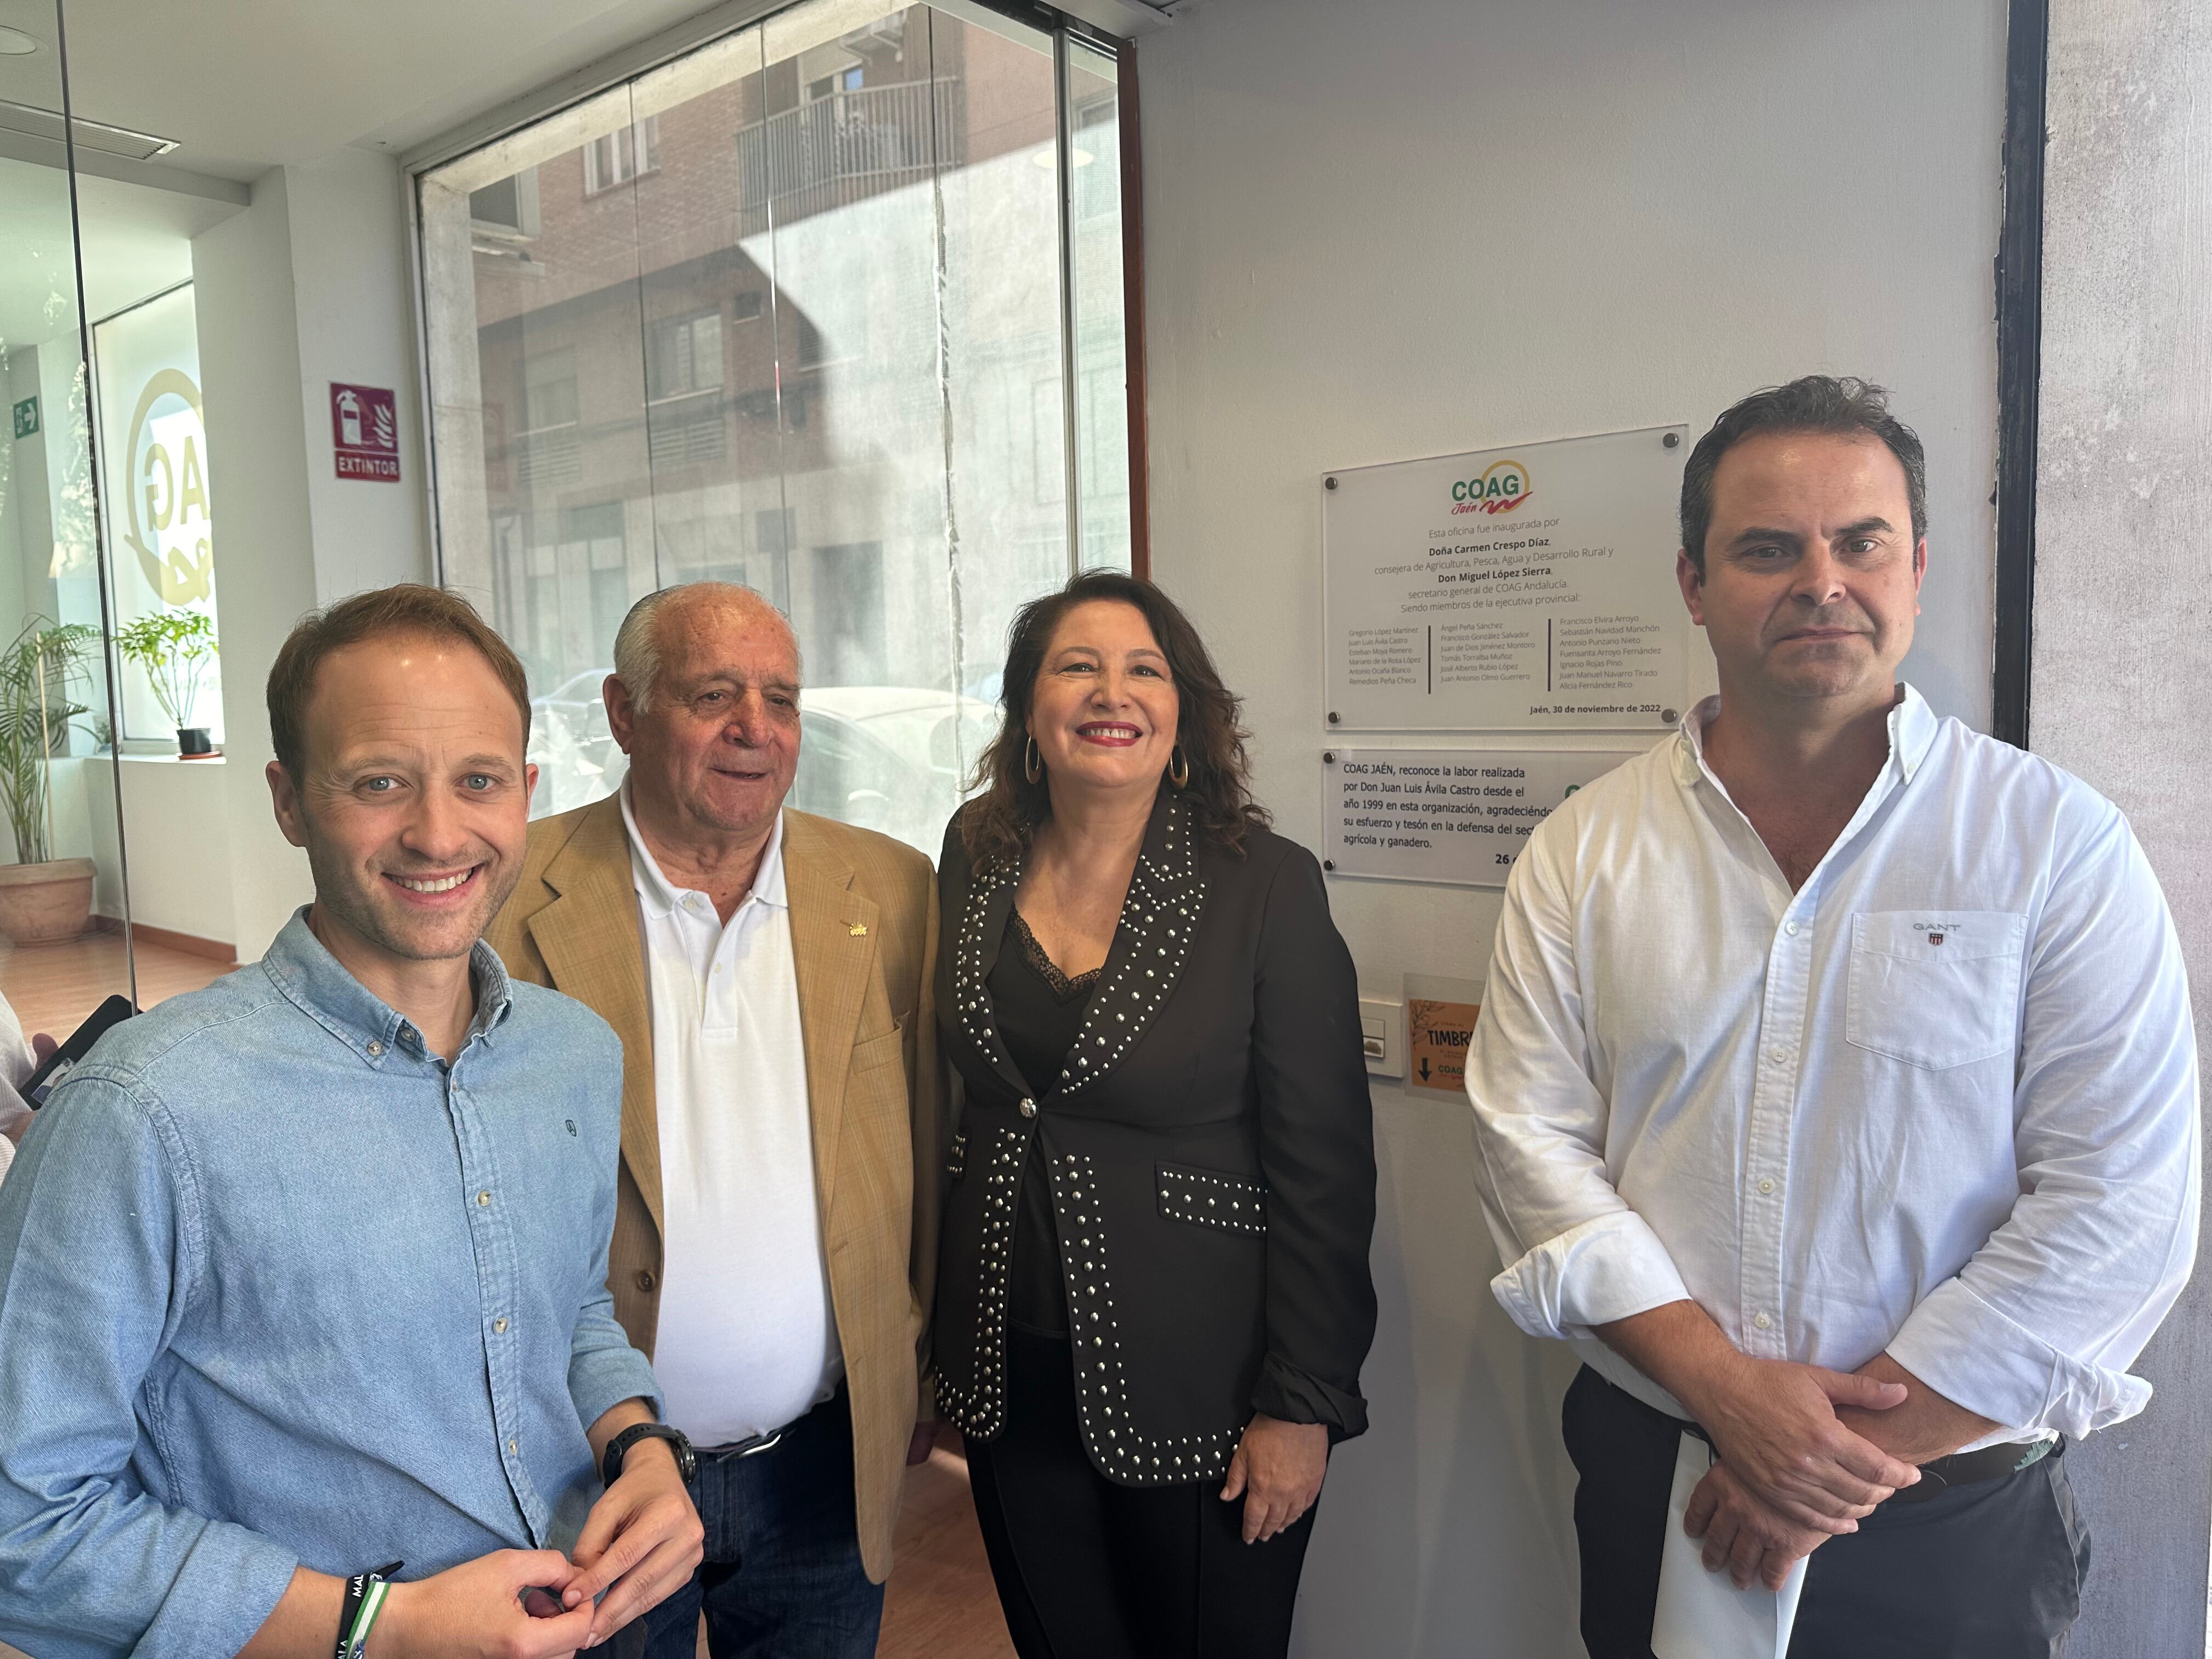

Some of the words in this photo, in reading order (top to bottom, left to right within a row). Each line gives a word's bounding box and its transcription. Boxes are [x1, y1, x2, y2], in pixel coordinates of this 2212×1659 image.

[337, 456, 399, 476] EXTINTOR
[1452, 475, 1519, 501] COAG
[1451, 502, 1477, 515] Jaén
[1429, 529, 1446, 538] Esta
[1448, 527, 1475, 537] oficina
[1477, 524, 1491, 534] fue
[1493, 520, 1541, 533] inaugurada
[1544, 518, 1560, 528] por
[1429, 547, 1452, 556] Doña
[1454, 543, 1490, 554] Carmen
[1493, 540, 1525, 551] Crespo
[1528, 537, 1551, 547] Díaz,
[1374, 565, 1412, 575] consejera
[1413, 563, 1424, 572] de
[1426, 560, 1471, 572] Agricultura,
[1474, 557, 1500, 566] Pesca,
[1502, 555, 1523, 566] Agua
[1525, 555, 1532, 565] y
[1533, 549, 1579, 562] Desarrollo
[1582, 546, 1606, 557] Rural
[1608, 548, 1613, 557] y
[1438, 574, 1456, 583] Don
[1459, 571, 1489, 583] Miguel
[1492, 569, 1520, 580] López
[1522, 567, 1553, 577] Sierra,
[1408, 589, 1448, 599] secretario
[1449, 585, 1480, 599] general
[1482, 585, 1493, 594] de
[1496, 583, 1521, 593] COAG
[1523, 579, 1570, 591] Andalucía.
[1401, 603, 1427, 613] Siendo
[1430, 601, 1471, 611] miembros
[1472, 600, 1484, 608] de
[1486, 599, 1493, 607] la
[1495, 596, 1532, 609] ejecutiva
[1536, 592, 1581, 606] provincial:
[1615, 616, 1639, 624] Arroyo
[1441, 623, 1458, 633] Ángel
[1476, 622, 1503, 630] Sánchez
[1560, 628, 1593, 636] Sebastián
[1501, 631, 1530, 640] Salvador
[1480, 643, 1505, 652] Jiménez
[1597, 649, 1621, 657] Arroyo
[1623, 647, 1661, 655] Fernández
[1440, 665, 1453, 674] José
[1499, 663, 1519, 671] López
[1560, 661, 1584, 670] Ignacio
[1586, 660, 1605, 669] Rojas
[1559, 672, 1575, 680] Juan
[1530, 706, 1550, 715] Jaén,
[1565, 705, 1575, 713] de
[1577, 704, 1624, 713] noviembre
[1627, 704, 1638, 713] de
[1344, 764, 1368, 774] COAG
[1370, 761, 1396, 776] JAÉN,
[1399, 767, 1440, 776] reconoce
[1443, 766, 1451, 776] la
[1454, 766, 1478, 777] labor
[1481, 767, 1525, 778] realizada
[1344, 783, 1358, 792] por
[1361, 782, 1378, 792] Don
[1380, 782, 1401, 793] Juan
[1404, 783, 1422, 793] Luis
[1425, 781, 1447, 794] Ávila
[1450, 785, 1480, 795] Castro
[1483, 786, 1512, 796] desde
[1515, 787, 1524, 797] el
[1344, 798, 1359, 809] año
[1363, 800, 1383, 809] 1999
[1386, 802, 1397, 810] en
[1400, 802, 1419, 811] esta
[1421, 803, 1483, 816] organización,
[1344, 817, 1353, 826] su
[1356, 817, 1392, 828] esfuerzo
[1395, 820, 1401, 830] y
[1403, 819, 1428, 830] tesón
[1431, 822, 1442, 831] en
[1446, 821, 1453, 831] la
[1457, 822, 1494, 833] defensa
[1498, 823, 1512, 834] del
[1344, 833, 1376, 845] agrícola
[1379, 838, 1385, 848] y
[1387, 837, 1432, 848] ganadero.
[1495, 854, 1509, 864] 26
[1913, 923, 1961, 932] GANT
[1438, 1065, 1463, 1075] COAG
